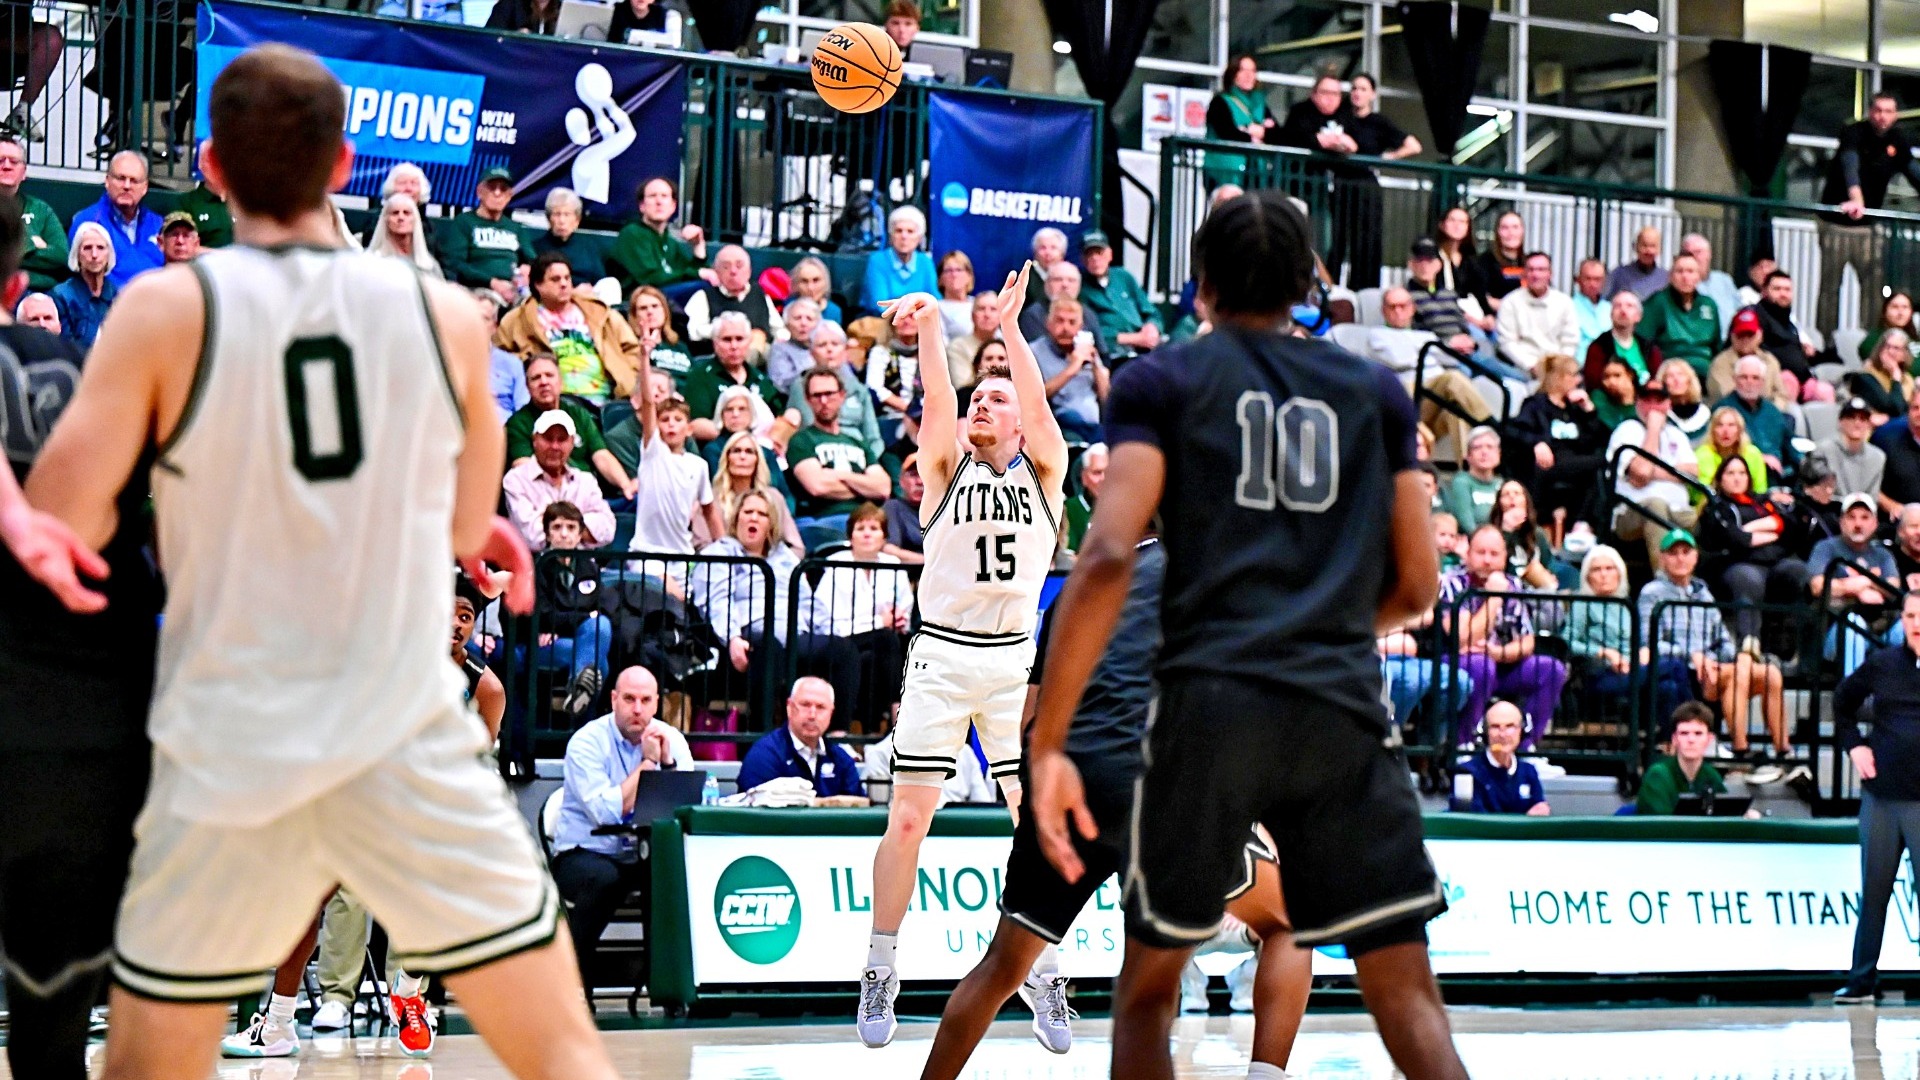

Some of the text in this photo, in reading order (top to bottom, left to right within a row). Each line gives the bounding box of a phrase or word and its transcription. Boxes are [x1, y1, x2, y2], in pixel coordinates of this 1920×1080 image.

[823, 33, 855, 51] NCA
[343, 85, 474, 146] PIONS
[475, 125, 518, 145] HERE
[481, 109, 515, 128] WIN
[969, 187, 1083, 224] BASKETBALL
[283, 334, 366, 482] 0
[1235, 389, 1340, 513] 10
[953, 482, 1033, 526] TITANS
[974, 532, 1017, 583] 15
[829, 867, 1004, 912] ILNOI
[1509, 890, 1860, 925] HOME OF THE TITAN
[720, 894, 796, 926] CCIW
